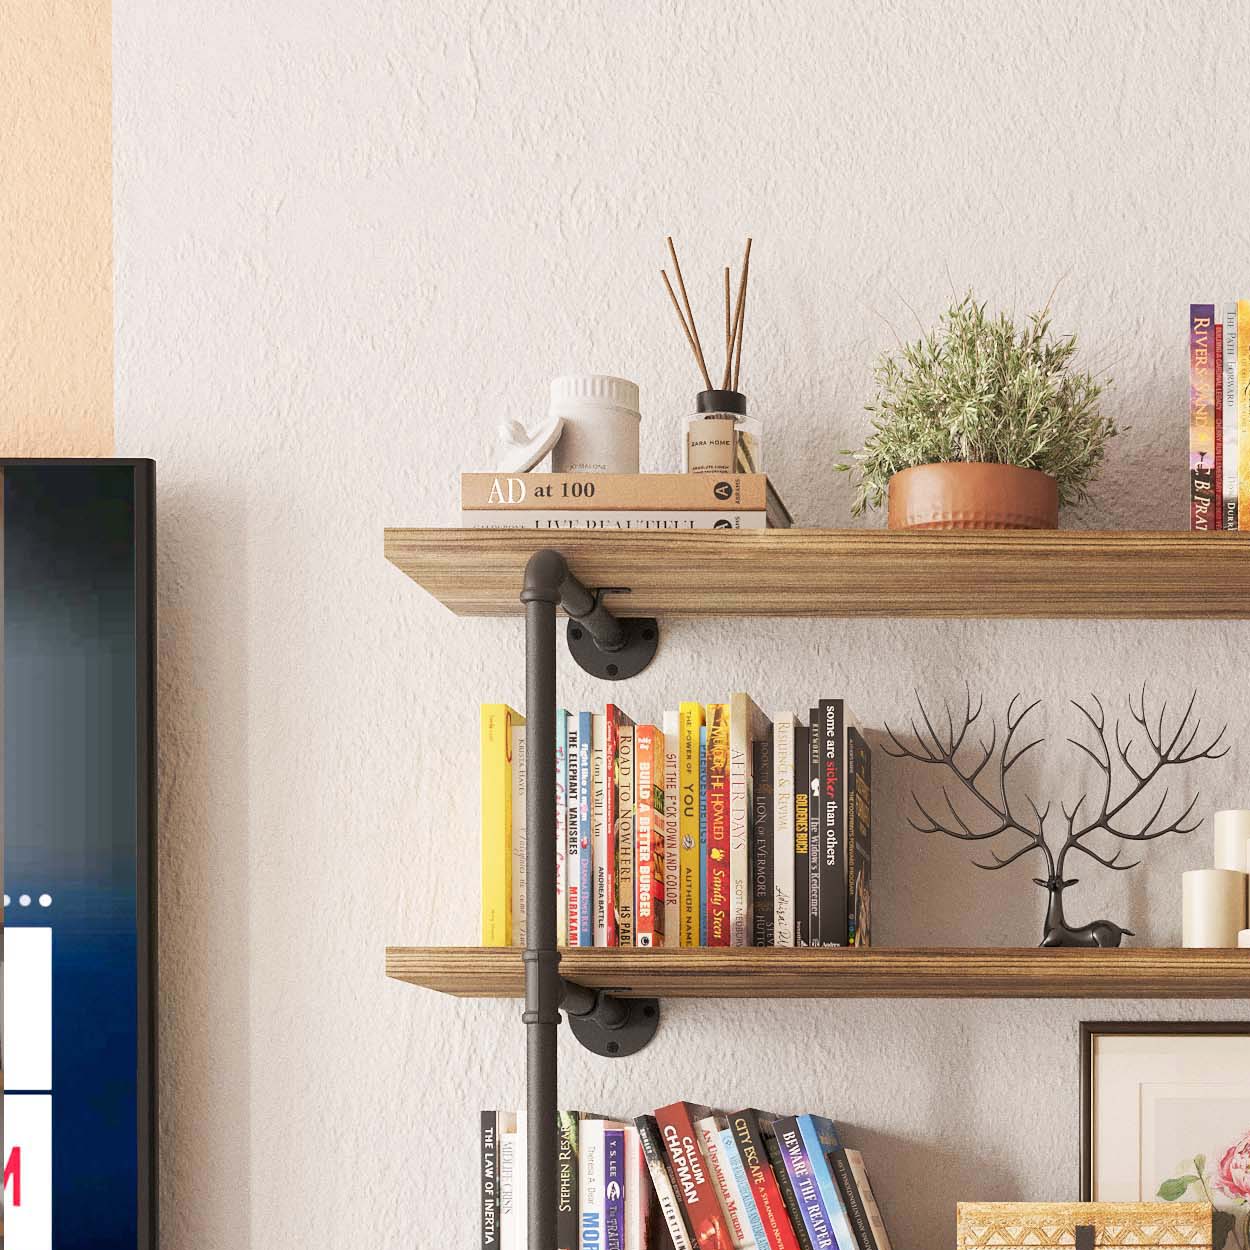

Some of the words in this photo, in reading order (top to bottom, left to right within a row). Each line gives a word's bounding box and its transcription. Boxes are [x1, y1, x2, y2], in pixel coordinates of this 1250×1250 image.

[488, 478, 526, 504] AD
[534, 485, 552, 498] at
[561, 482, 594, 498] 100
[569, 731, 577, 748] THE
[826, 706, 835, 738] some
[620, 736, 631, 775] ROAD
[666, 754, 676, 769] SIT
[826, 740, 835, 758] are
[569, 754, 577, 800] ELEPHANT
[620, 785, 630, 801] TO
[640, 762, 650, 799] BUILD
[666, 773, 676, 789] THE
[732, 750, 744, 801] AFTER
[826, 761, 837, 798] sicker
[640, 803, 650, 812] A
[684, 784, 694, 817] YOU
[796, 794, 808, 832] GOLDENES
[826, 801, 837, 826] than
[569, 808, 577, 855] VANISHES
[620, 810, 632, 882] NOWHERE
[640, 817, 650, 861] BETTER
[666, 822, 677, 848] DOWN
[732, 809, 745, 849] DAYS
[796, 834, 808, 853] BUCH
[666, 853, 677, 870] AND
[826, 830, 837, 866] others
[640, 866, 650, 917] BURGER
[666, 875, 677, 905] COLOR
[711, 869, 726, 905] Sandy
[811, 873, 819, 916] Redeemer
[714, 909, 724, 938] Steen
[485, 1128, 493, 1148] THE
[610, 1141, 616, 1149] Y.
[735, 1119, 752, 1143] CITY
[744, 1146, 765, 1184] ESCAPE
[783, 1131, 808, 1177] BEWARE
[485, 1153, 493, 1178] LAW
[664, 1125, 699, 1204] CHAPMAN
[683, 1136, 705, 1184] CALLUM
[485, 1182, 493, 1196] OF
[709, 1145, 731, 1200] UNFAMILIAR
[728, 1201, 745, 1240] MURDER
[800, 1178, 818, 1204] THE
[485, 1200, 494, 1244] INERTIA
[807, 1205, 832, 1248] REAPER
